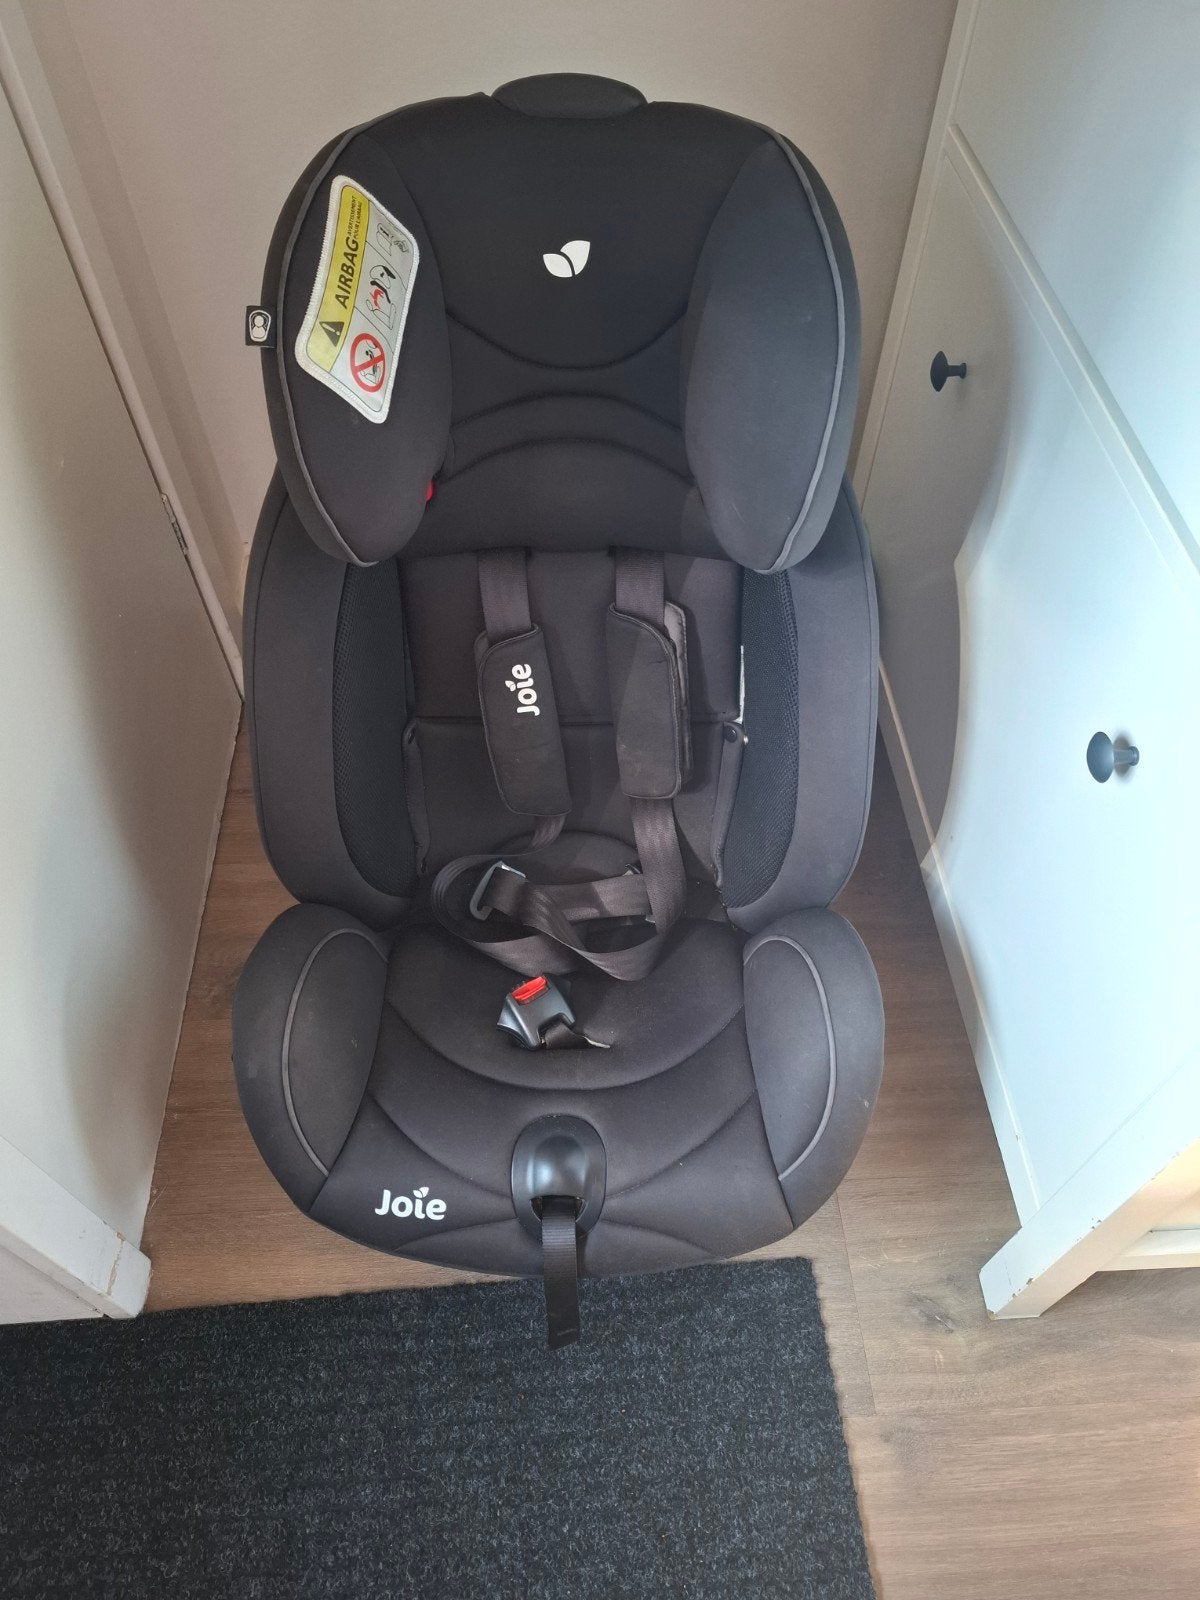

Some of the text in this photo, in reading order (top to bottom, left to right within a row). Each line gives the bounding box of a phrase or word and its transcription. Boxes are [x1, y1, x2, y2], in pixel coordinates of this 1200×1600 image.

[347, 195, 357, 236] AVERTISSEMENT
[334, 236, 359, 310] AIRBAG
[505, 663, 541, 717] Joie
[374, 1186, 447, 1221] Joie
